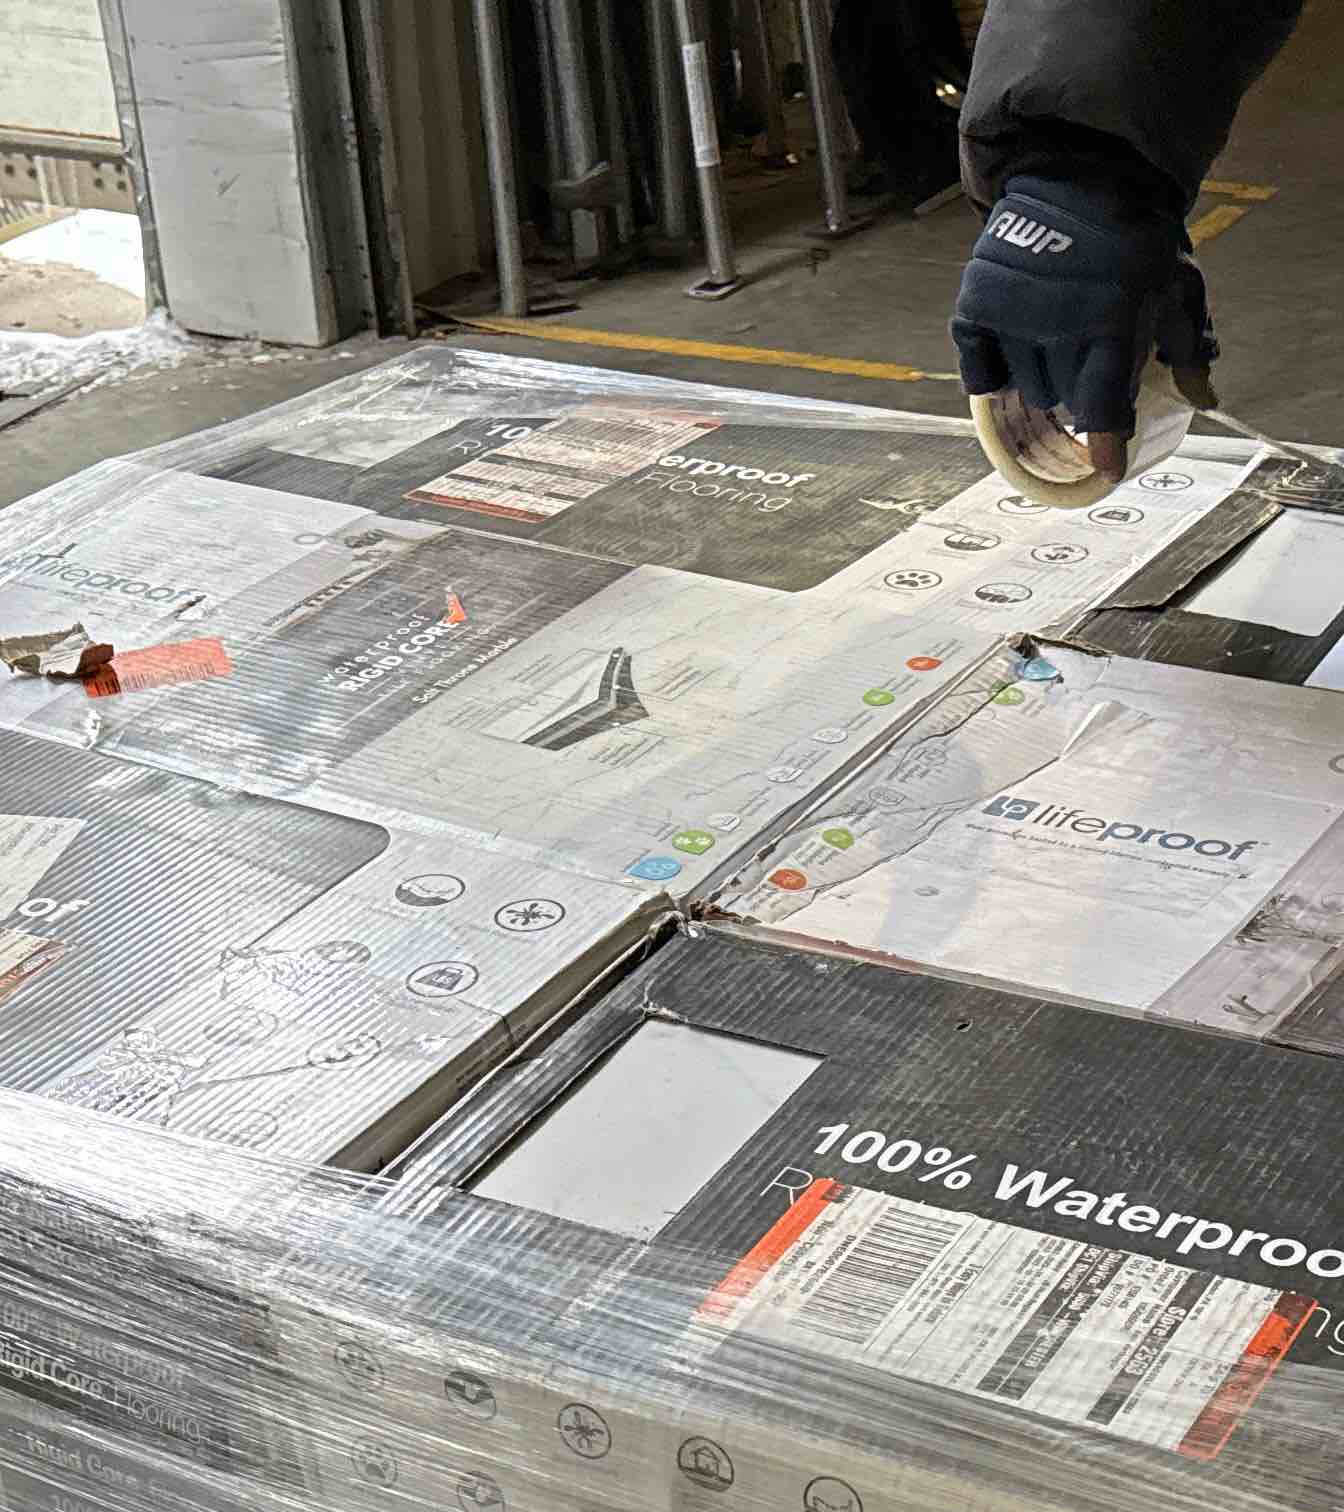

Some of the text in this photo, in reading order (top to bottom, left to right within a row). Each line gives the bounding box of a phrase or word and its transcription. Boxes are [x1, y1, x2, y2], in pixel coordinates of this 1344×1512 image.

[987, 210, 1074, 256] AWP
[338, 654, 404, 693] RIGID
[1031, 804, 1259, 862] lifeproof
[813, 1122, 979, 1192] 100%
[50, 1361, 105, 1398] Core
